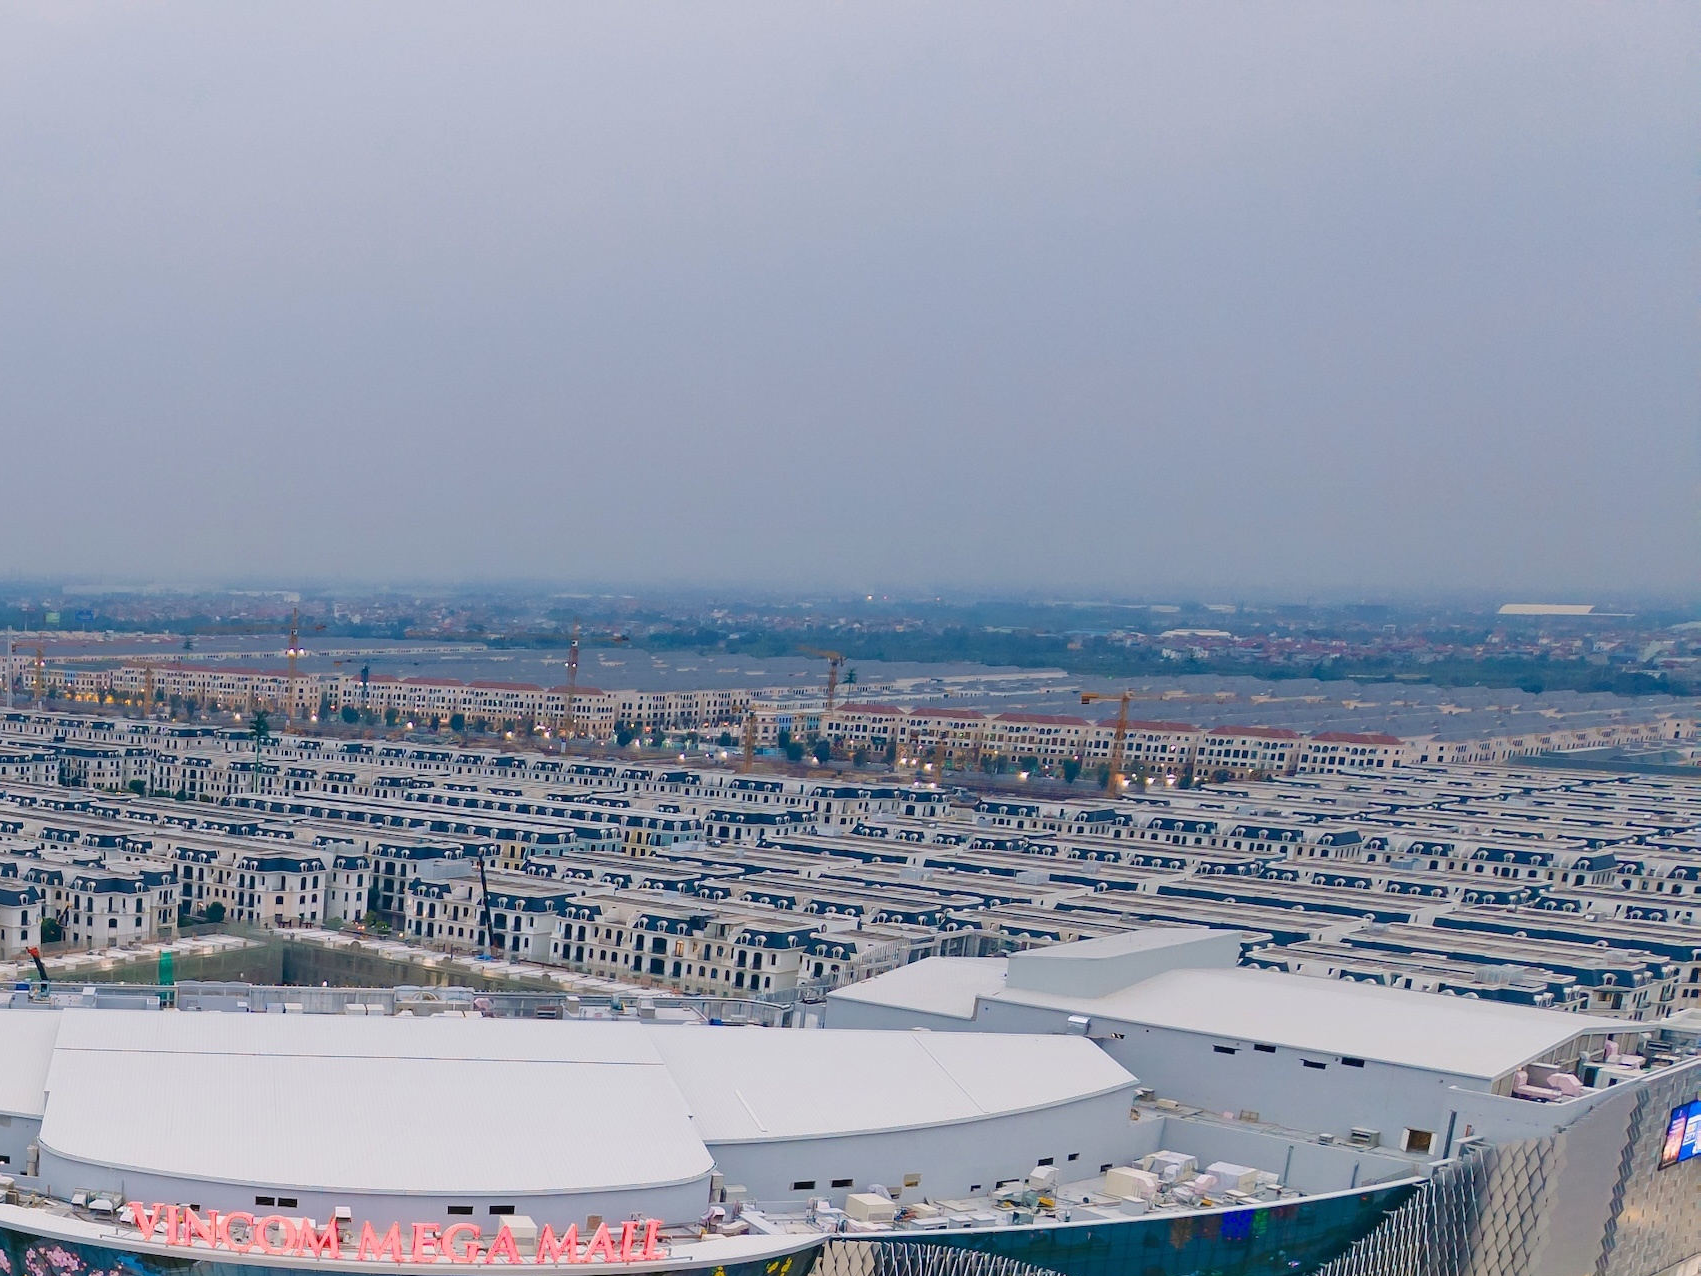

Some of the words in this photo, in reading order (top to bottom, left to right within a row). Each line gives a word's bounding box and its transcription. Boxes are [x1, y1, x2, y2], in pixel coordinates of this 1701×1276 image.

[128, 1201, 345, 1260] VINCOM
[355, 1220, 524, 1265] MEGA
[534, 1218, 667, 1264] MALL
